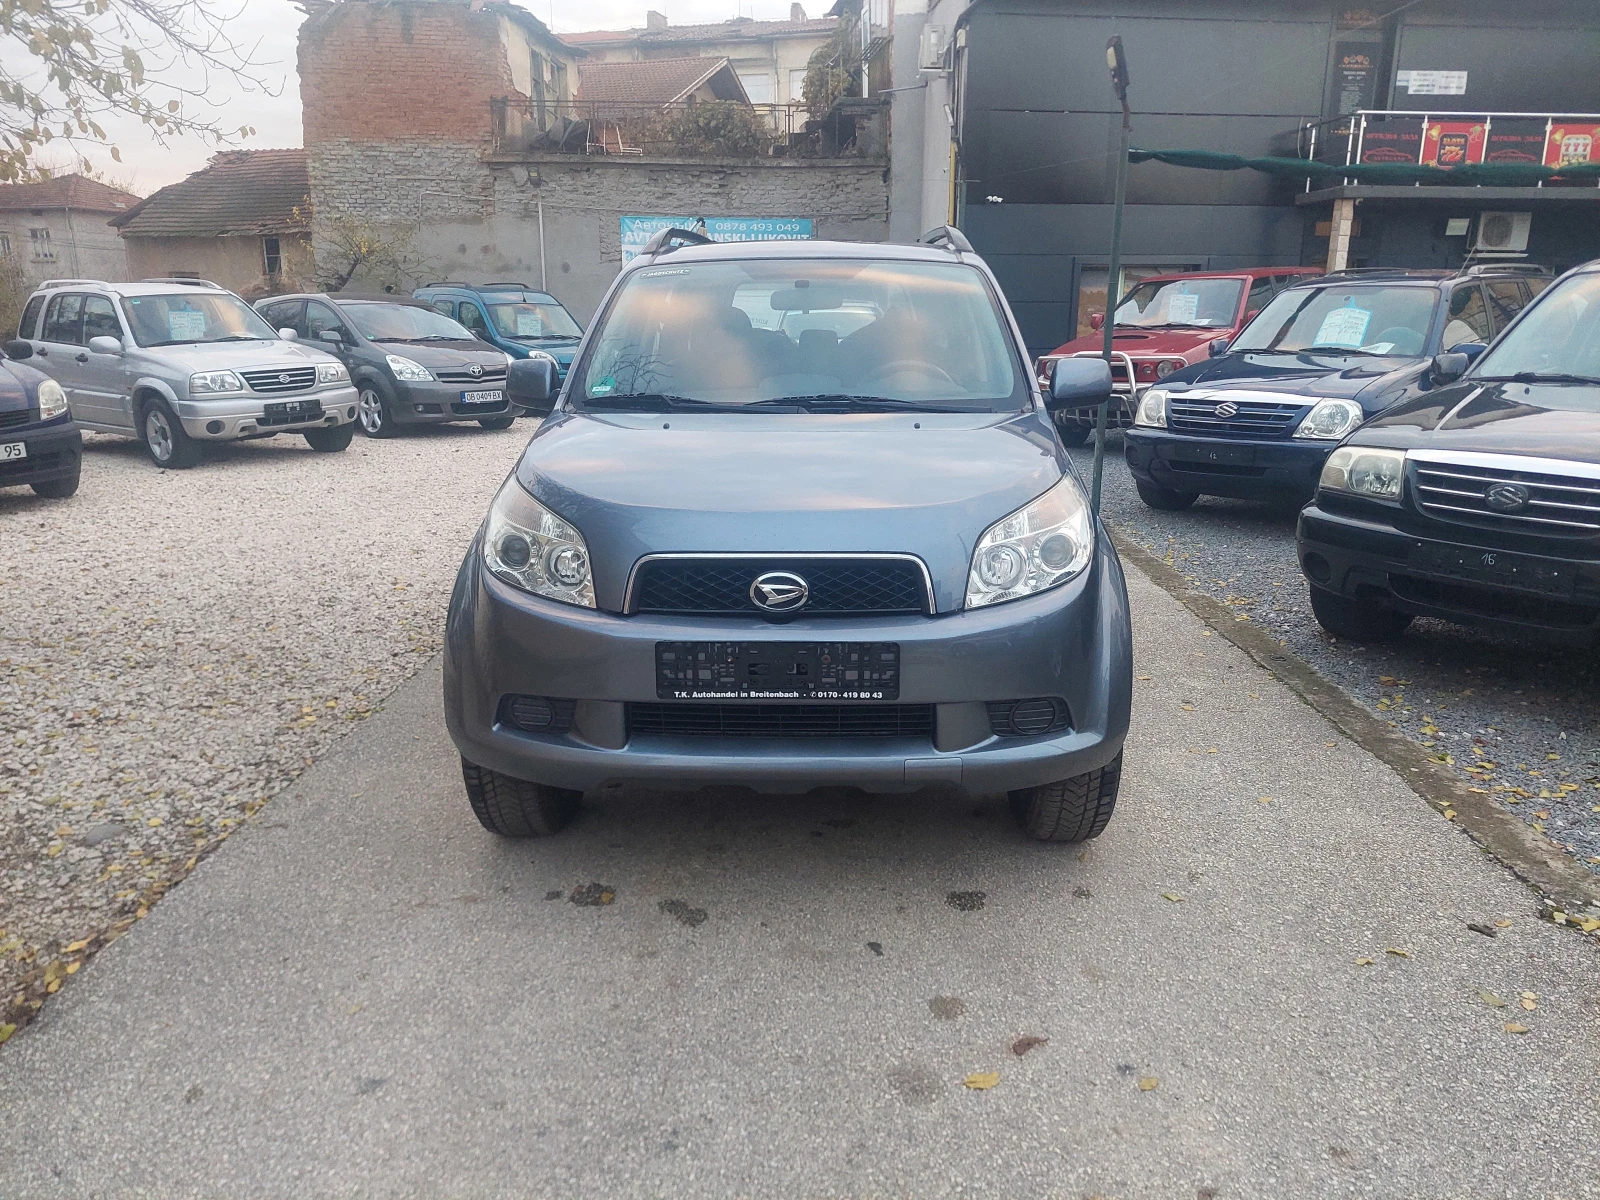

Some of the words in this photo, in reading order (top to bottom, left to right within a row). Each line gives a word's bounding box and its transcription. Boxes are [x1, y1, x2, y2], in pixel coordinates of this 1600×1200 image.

[715, 222, 747, 231] 0878
[749, 223, 773, 231] 493
[776, 223, 800, 232] 049
[4, 444, 21, 458] 95
[1481, 552, 1497, 565] 16
[692, 690, 738, 698] Autohandel
[740, 690, 748, 698] in
[750, 690, 799, 698] Breitenbach
[872, 691, 883, 699] 43
